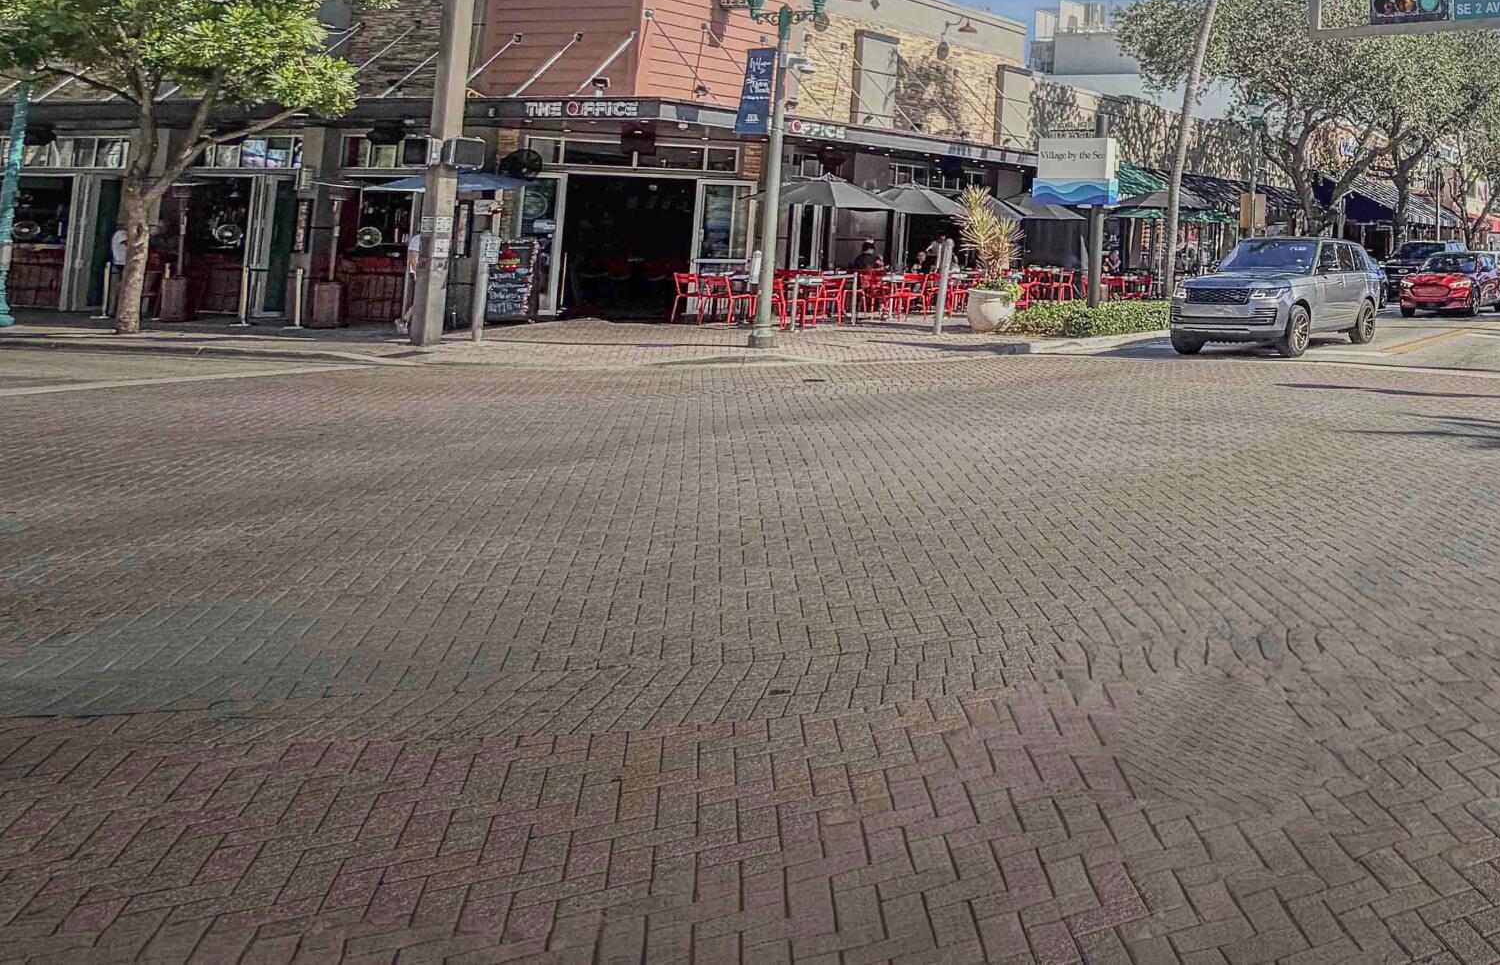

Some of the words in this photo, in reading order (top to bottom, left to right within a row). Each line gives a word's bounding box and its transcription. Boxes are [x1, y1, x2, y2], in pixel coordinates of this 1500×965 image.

[1456, 3, 1471, 15] SE
[1475, 2, 1482, 14] 2
[524, 101, 562, 117] THE
[566, 101, 638, 116] OFFICE
[788, 120, 846, 139] OFFICE
[1041, 151, 1066, 161] Village
[1068, 151, 1077, 161] by
[1080, 151, 1091, 159] the
[1093, 151, 1106, 160] Sea
